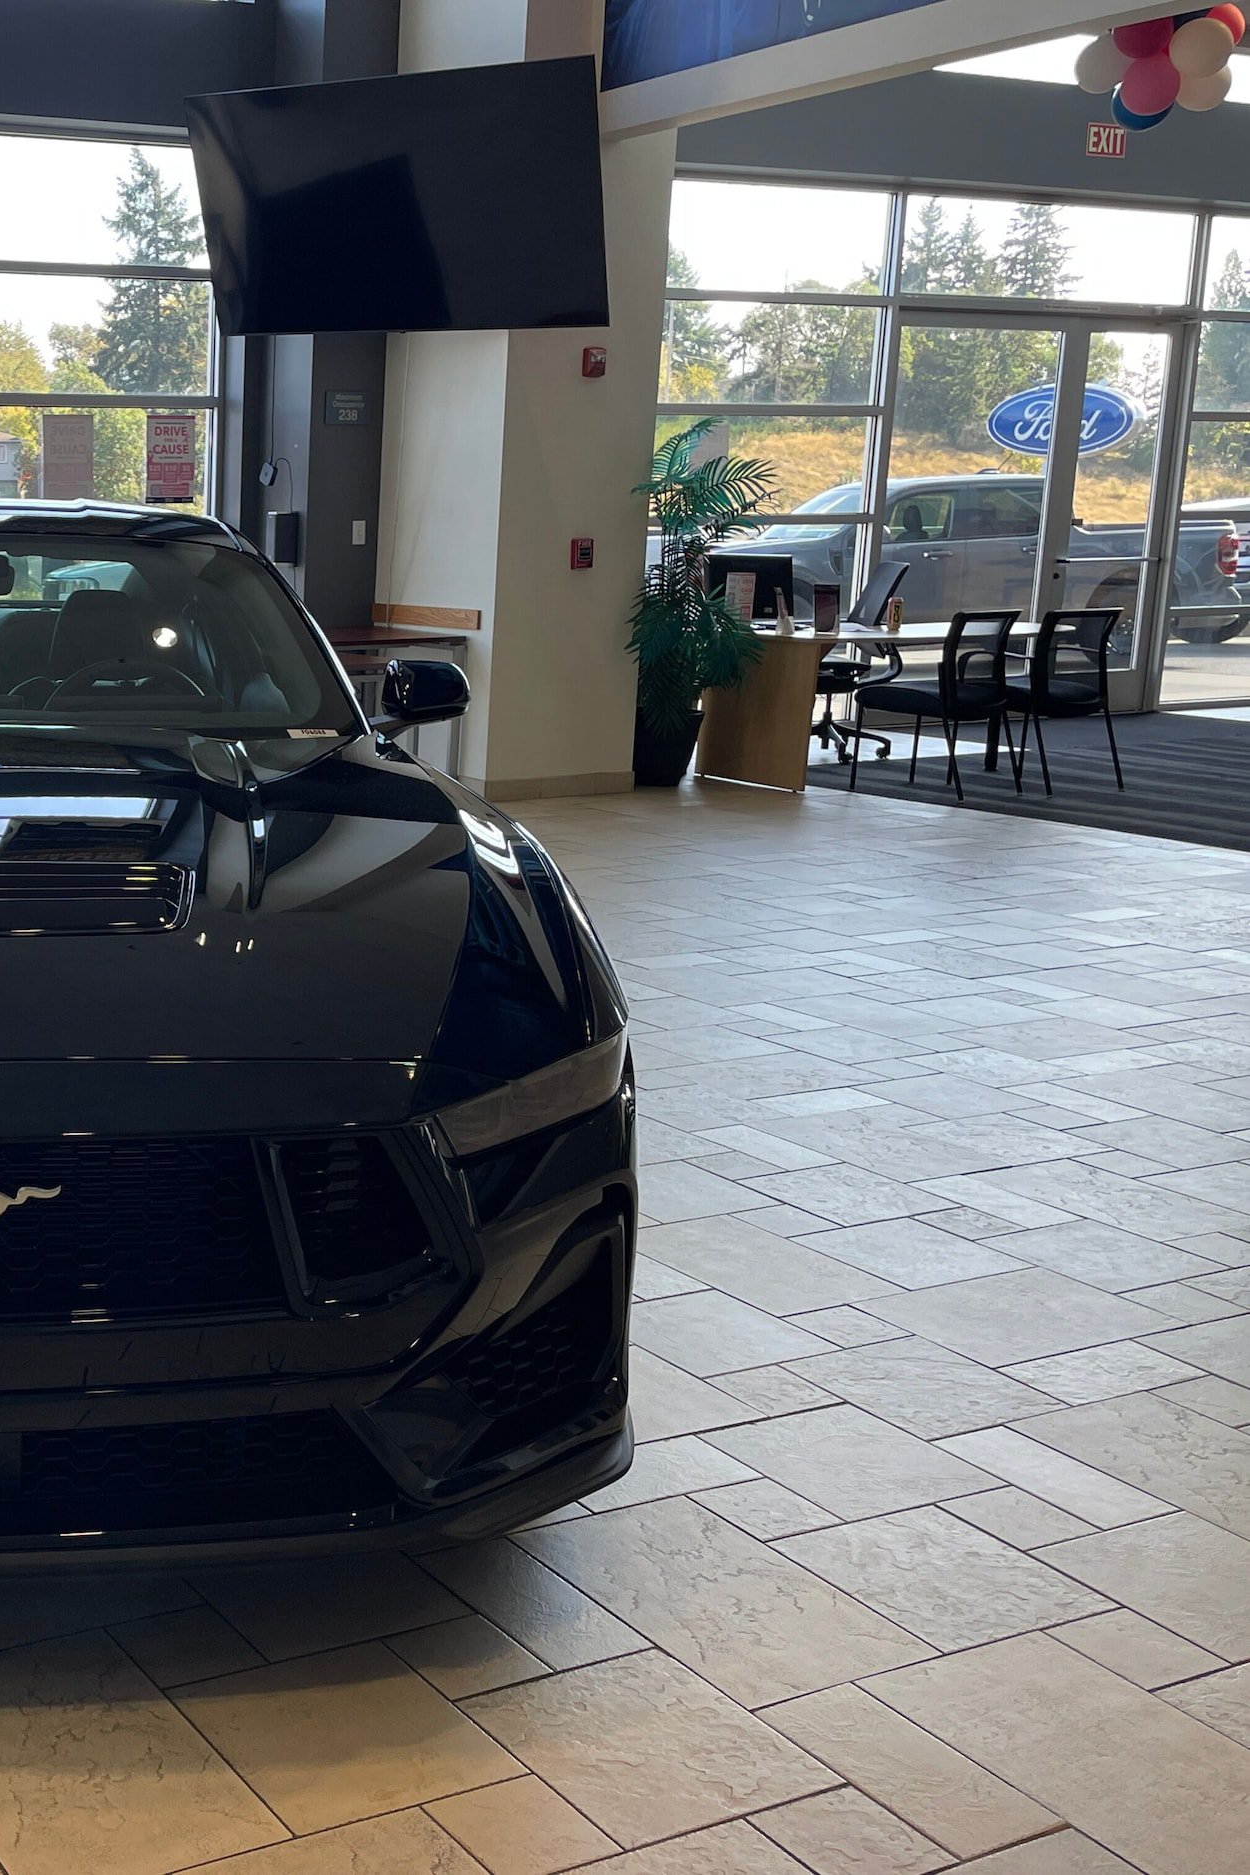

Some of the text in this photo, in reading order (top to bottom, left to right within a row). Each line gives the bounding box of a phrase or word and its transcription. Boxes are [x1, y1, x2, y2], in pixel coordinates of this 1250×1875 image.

[1088, 126, 1125, 154] EXIT
[339, 409, 358, 421] 238
[1014, 400, 1102, 441] Fod
[154, 426, 188, 436] DRIVE
[153, 444, 189, 455] CAUSE
